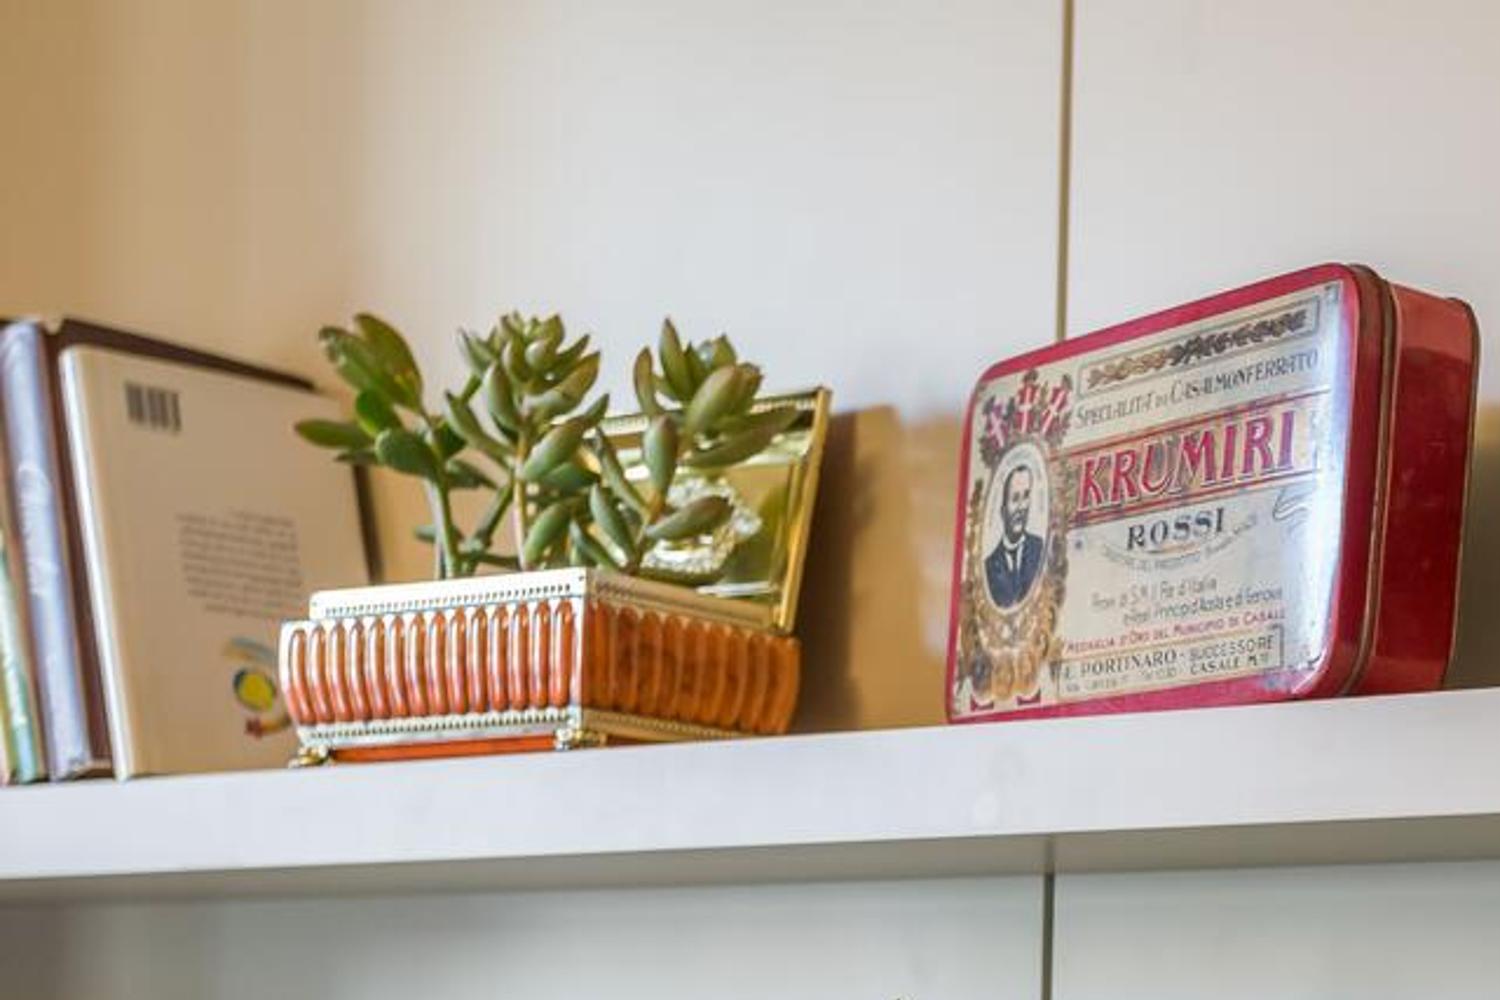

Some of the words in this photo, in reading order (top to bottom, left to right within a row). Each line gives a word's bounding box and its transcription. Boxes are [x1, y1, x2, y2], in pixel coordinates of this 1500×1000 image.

[1078, 409, 1295, 513] KRUMIRI
[1126, 507, 1225, 551] ROSSI
[1244, 607, 1286, 624] CASALE
[1188, 634, 1275, 662] SUCCESSORE
[1190, 657, 1240, 676] CASALE
